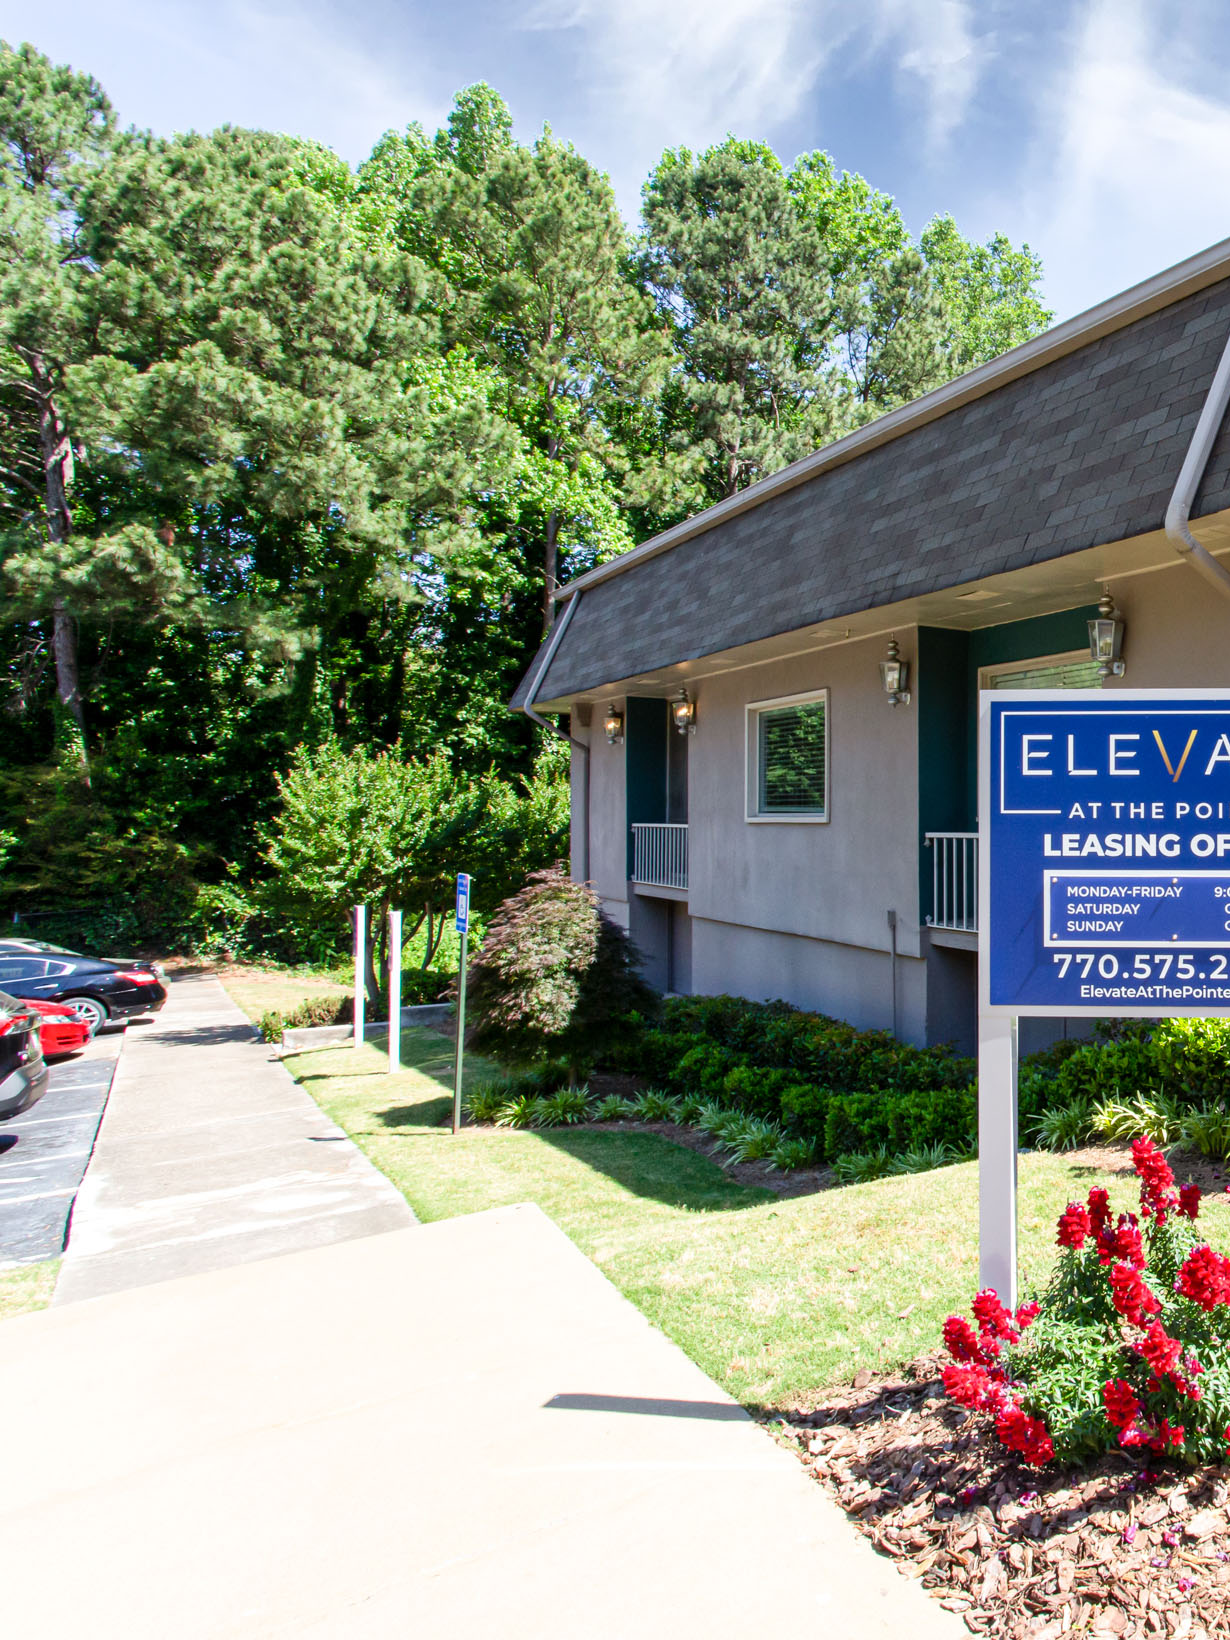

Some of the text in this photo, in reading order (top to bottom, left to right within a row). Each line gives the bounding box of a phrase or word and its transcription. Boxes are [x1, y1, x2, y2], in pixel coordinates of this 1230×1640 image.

[1069, 803, 1101, 818] AT
[1111, 803, 1164, 818] THE
[1044, 834, 1180, 857] LEASING
[1067, 886, 1183, 897] MONDAY-FRIDAY
[1067, 904, 1140, 914] SATURDAY
[1067, 921, 1123, 931] SUNDAY
